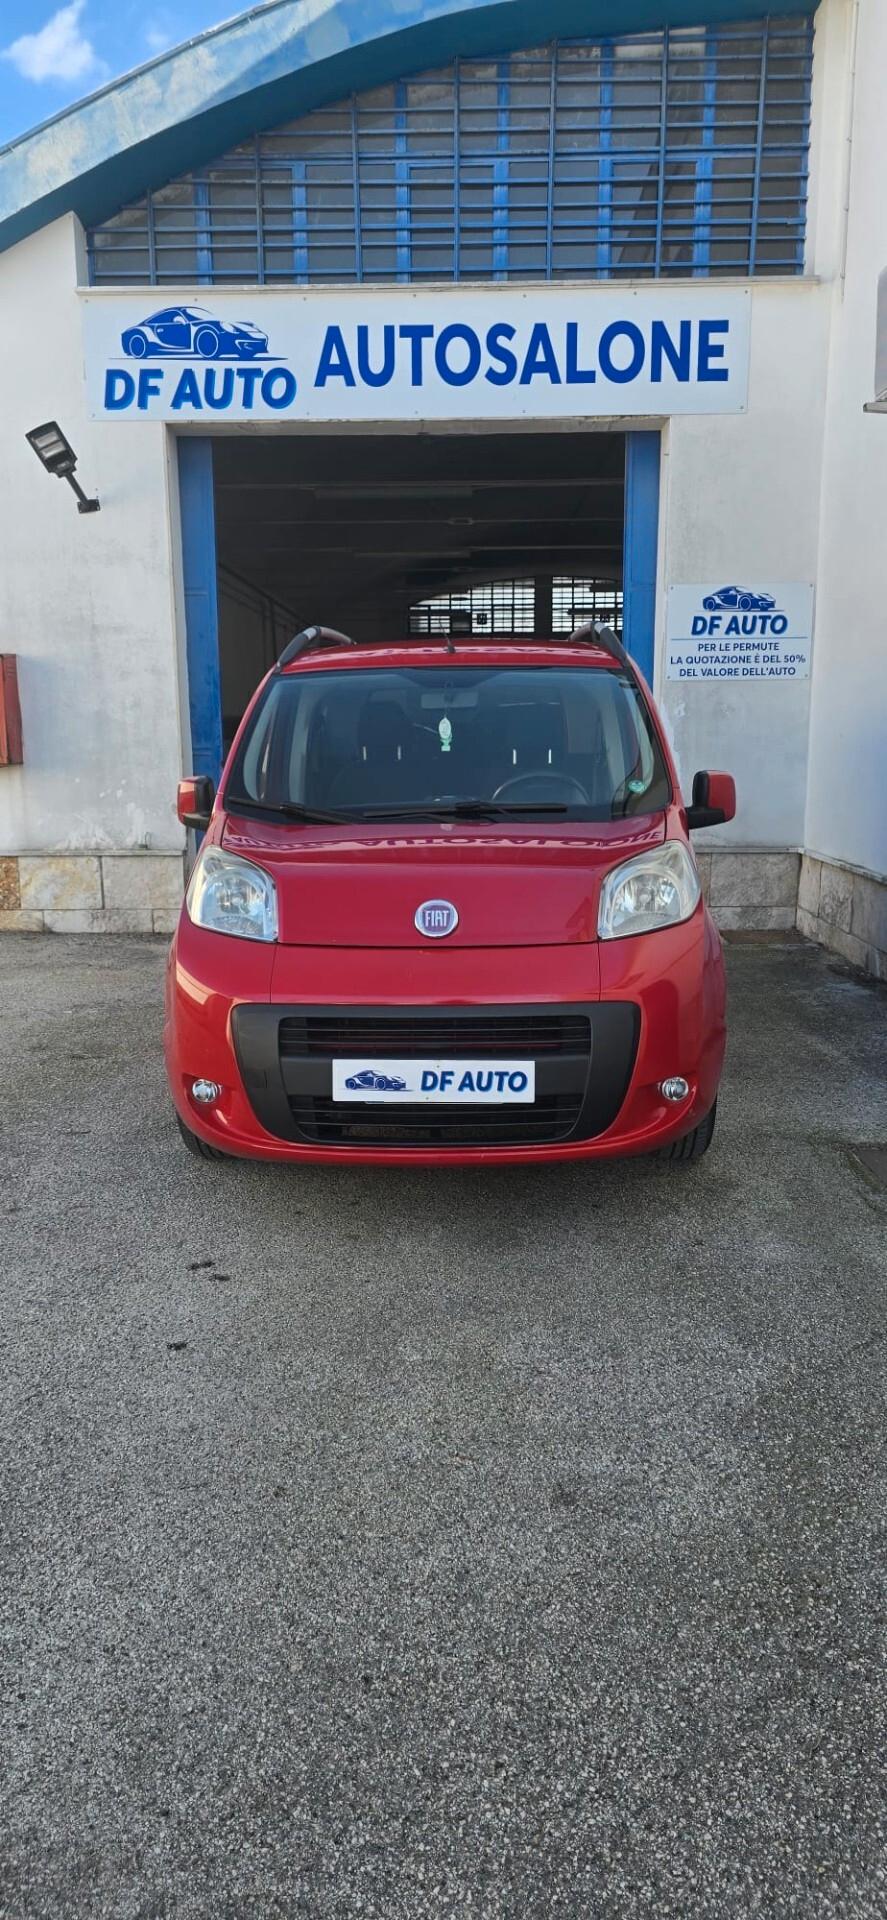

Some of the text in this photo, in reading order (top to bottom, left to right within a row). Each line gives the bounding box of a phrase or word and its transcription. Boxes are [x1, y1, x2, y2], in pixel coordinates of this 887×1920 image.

[313, 319, 730, 388] AUTOSALONE
[103, 366, 298, 411] DF AUTO
[691, 614, 788, 636] DF AUTO
[697, 642, 779, 652] PER LE PERMUTE
[670, 653, 806, 665] LA QUOTAZIONE È DEL 50%
[679, 667, 796, 677] DEL VALORE DELL'AUTO
[424, 910, 449, 927] FIAT
[420, 1070, 528, 1092] DF AUTO
